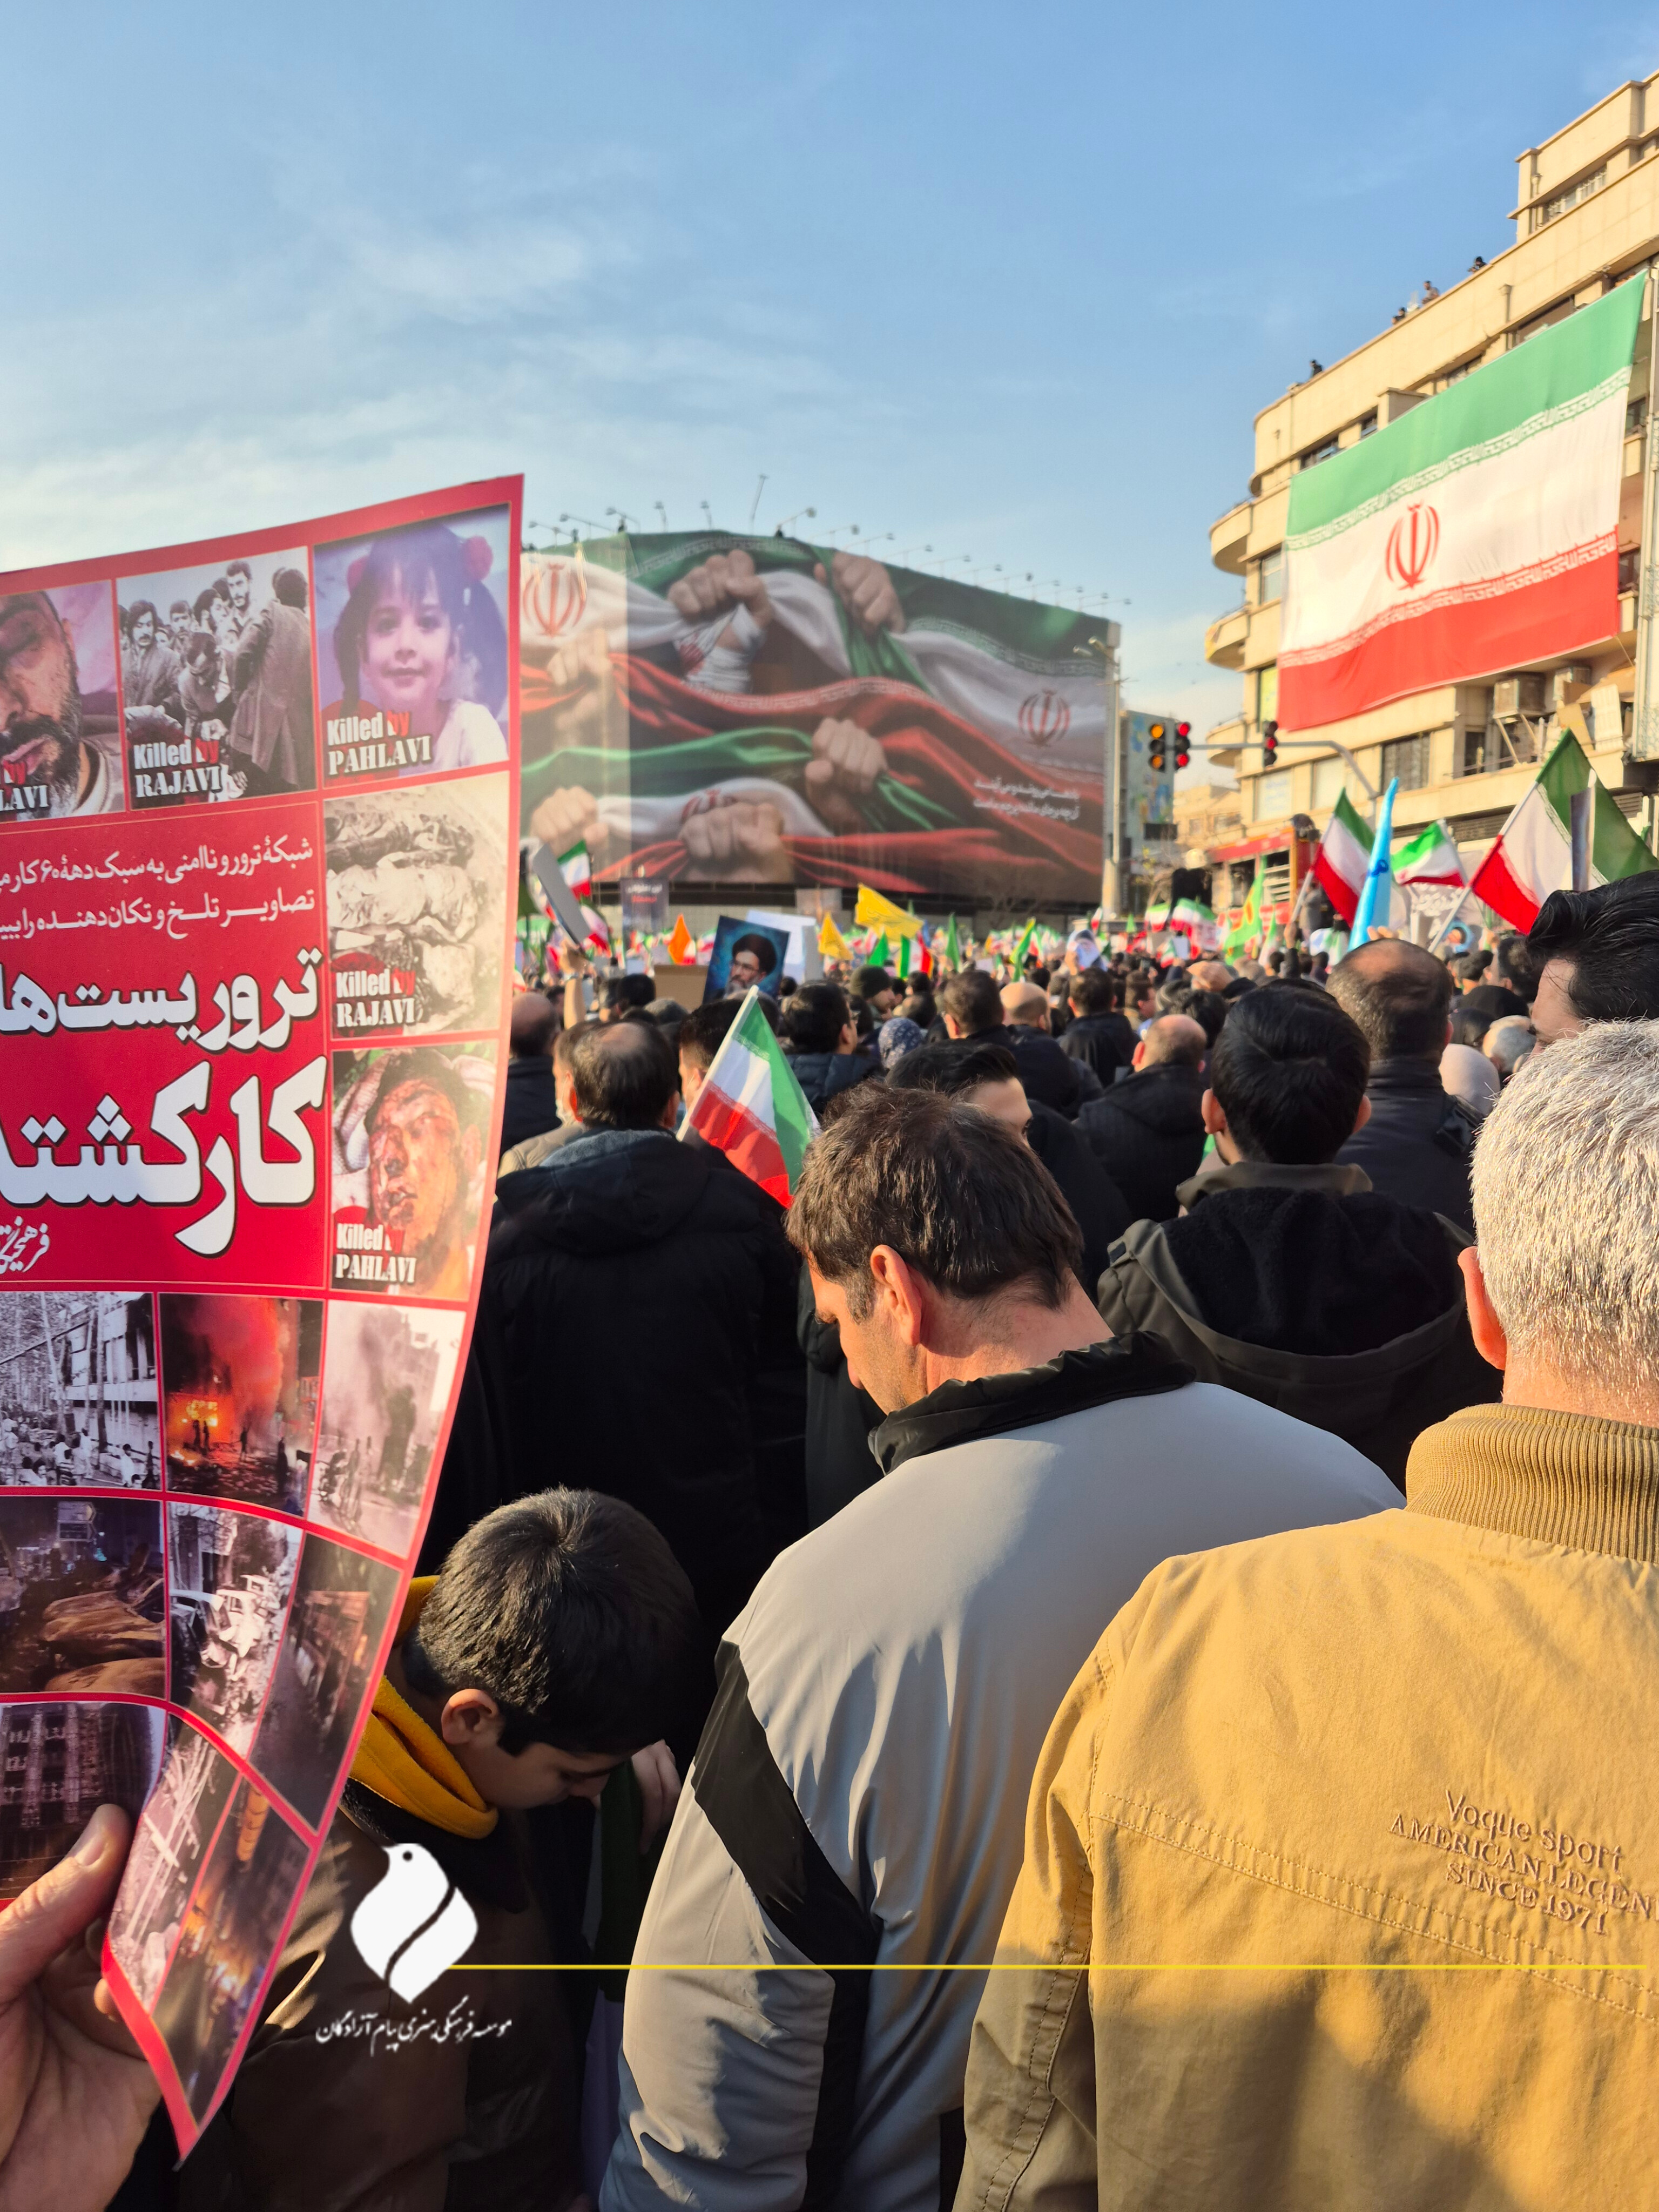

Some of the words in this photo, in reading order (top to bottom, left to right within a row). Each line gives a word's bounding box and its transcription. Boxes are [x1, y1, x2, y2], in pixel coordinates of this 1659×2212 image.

[327, 712, 383, 746] Killed
[387, 710, 409, 737] by
[134, 739, 192, 769] Killed
[195, 738, 219, 764] by
[328, 736, 431, 775] PAHLAVI
[0, 785, 49, 811] LAVI
[134, 766, 221, 798] RAJAVI
[94, 850, 145, 884] سبک
[146, 857, 164, 881] به
[165, 845, 218, 884] ناامنی
[228, 845, 261, 876] ترور
[152, 909, 165, 930] و
[167, 892, 219, 940] تلخ
[220, 887, 315, 927] تصاویر
[336, 968, 390, 998] Killed
[394, 967, 416, 996] by
[336, 998, 415, 1027] RAJAVI
[337, 1223, 383, 1250] Killed
[385, 1225, 404, 1254] by
[335, 1253, 416, 1283] PAHLAVI
[1389, 1813, 1546, 1881] AMERICAN
[1547, 1863, 1659, 1921] LEGEN
[1541, 1829, 1622, 1874] sport
[1446, 1863, 1539, 1908] SINCE
[1543, 1894, 1607, 1935] 1971
